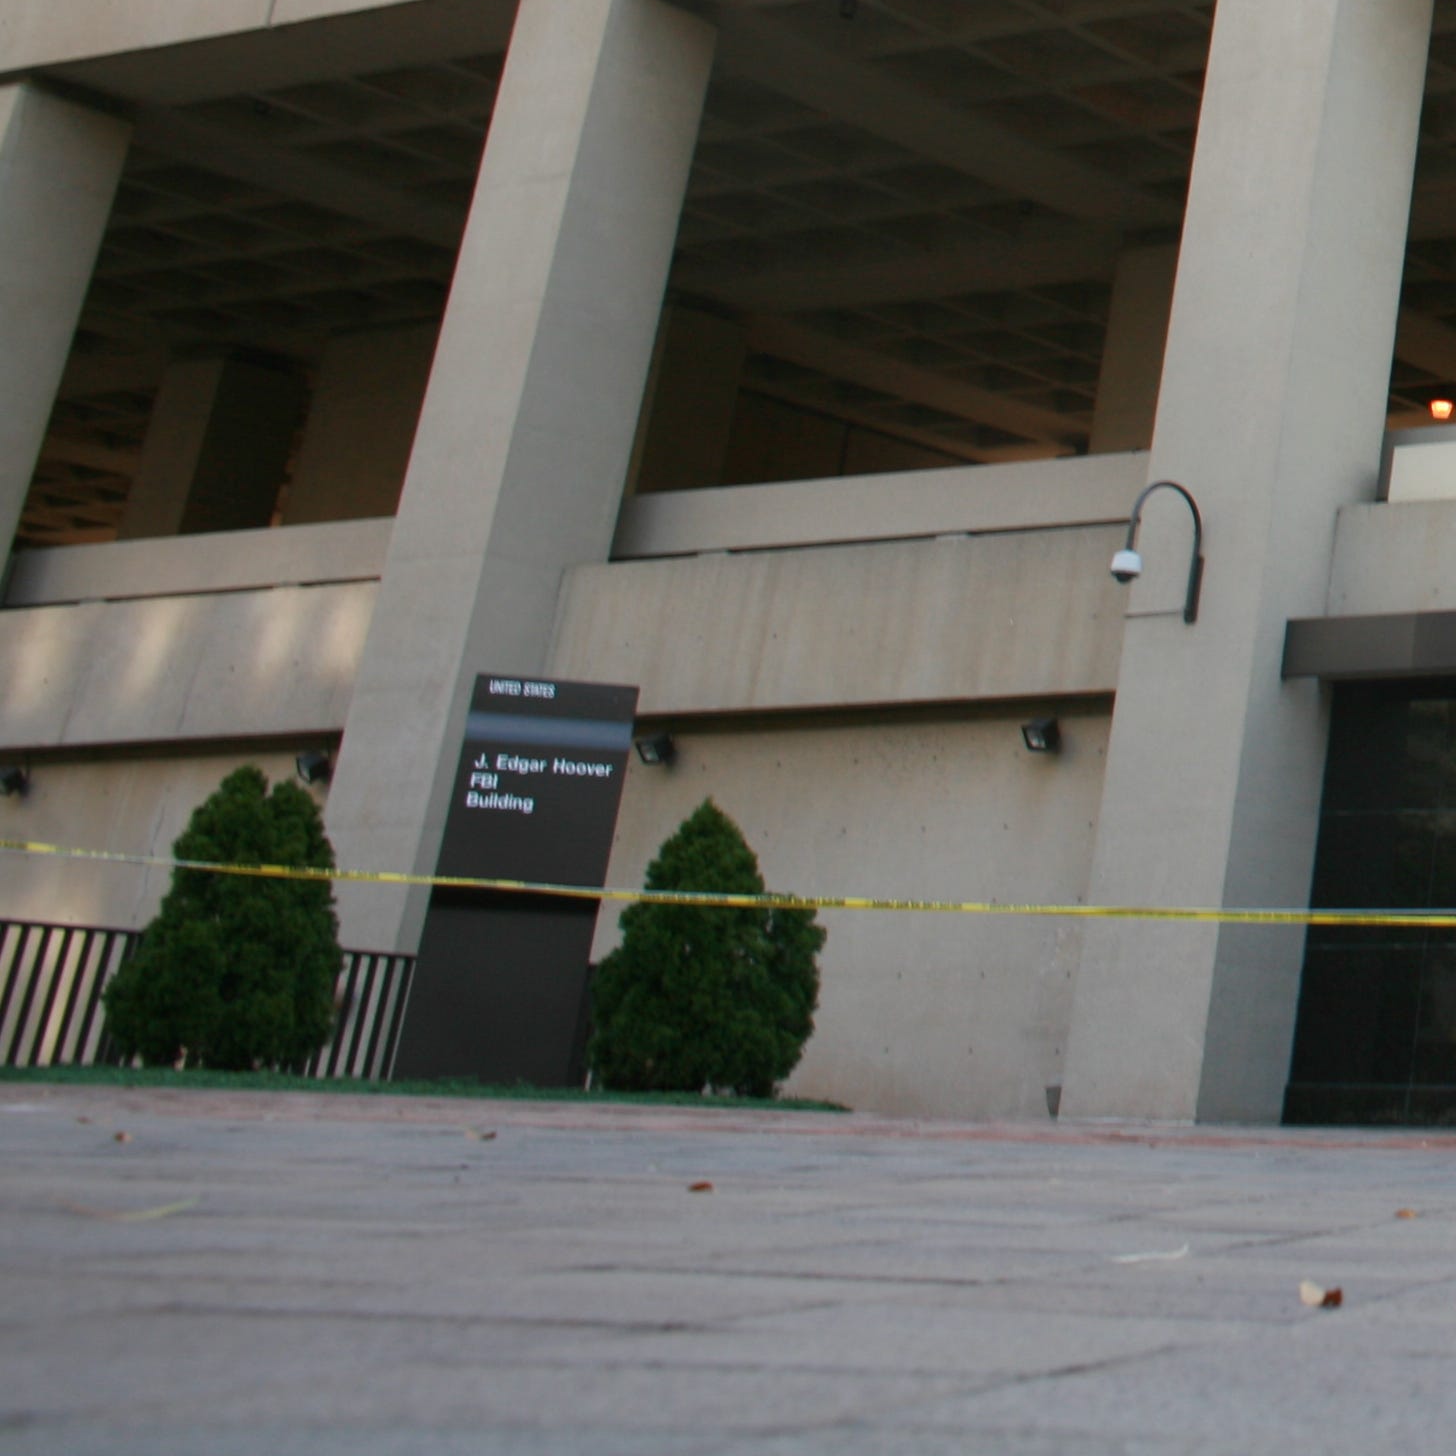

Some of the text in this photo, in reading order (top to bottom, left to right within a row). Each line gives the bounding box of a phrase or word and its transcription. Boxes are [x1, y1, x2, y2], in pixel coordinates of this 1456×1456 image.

[489, 679, 556, 699] UNITED STATES
[474, 753, 613, 777] J. Edgar Hoover
[470, 772, 498, 790] FBI
[466, 791, 534, 814] Building
